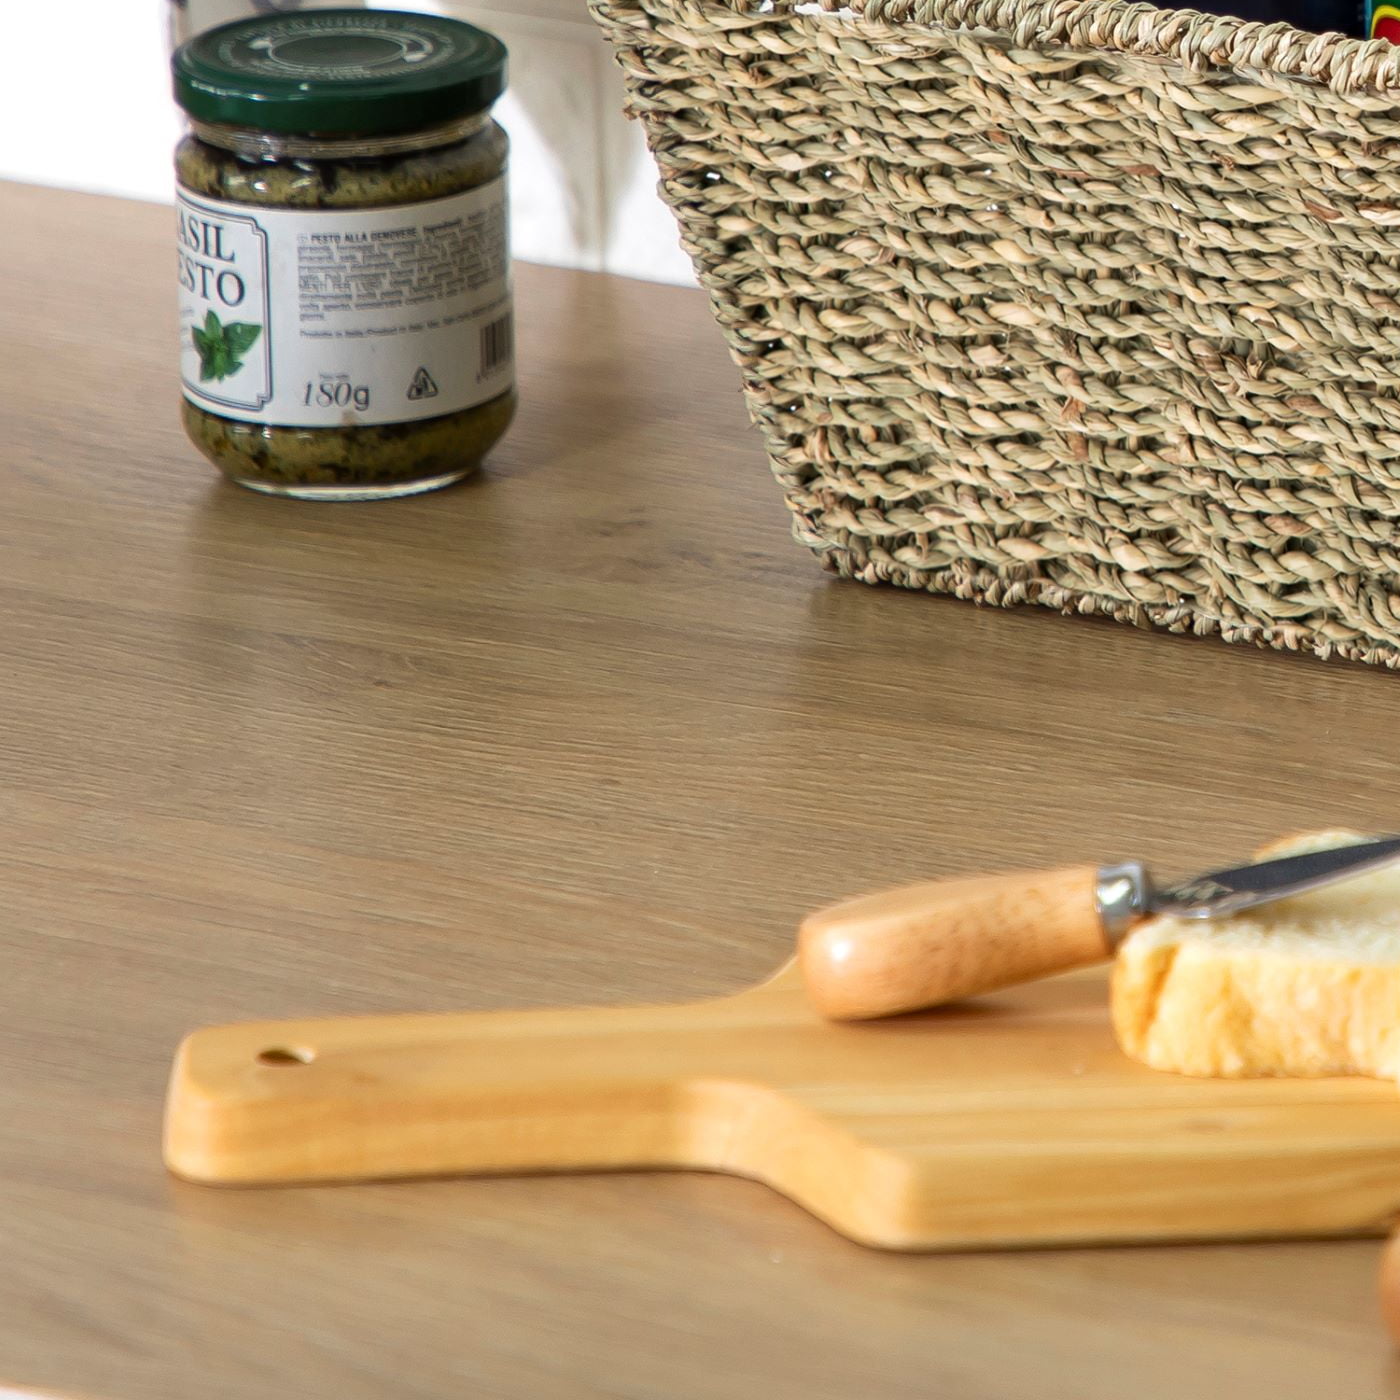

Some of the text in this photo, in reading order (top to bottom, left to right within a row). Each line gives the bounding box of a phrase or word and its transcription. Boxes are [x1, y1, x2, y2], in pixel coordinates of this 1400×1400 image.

[179, 209, 236, 264] ASIL
[178, 247, 246, 307] ESTO
[303, 380, 370, 411] 180g
